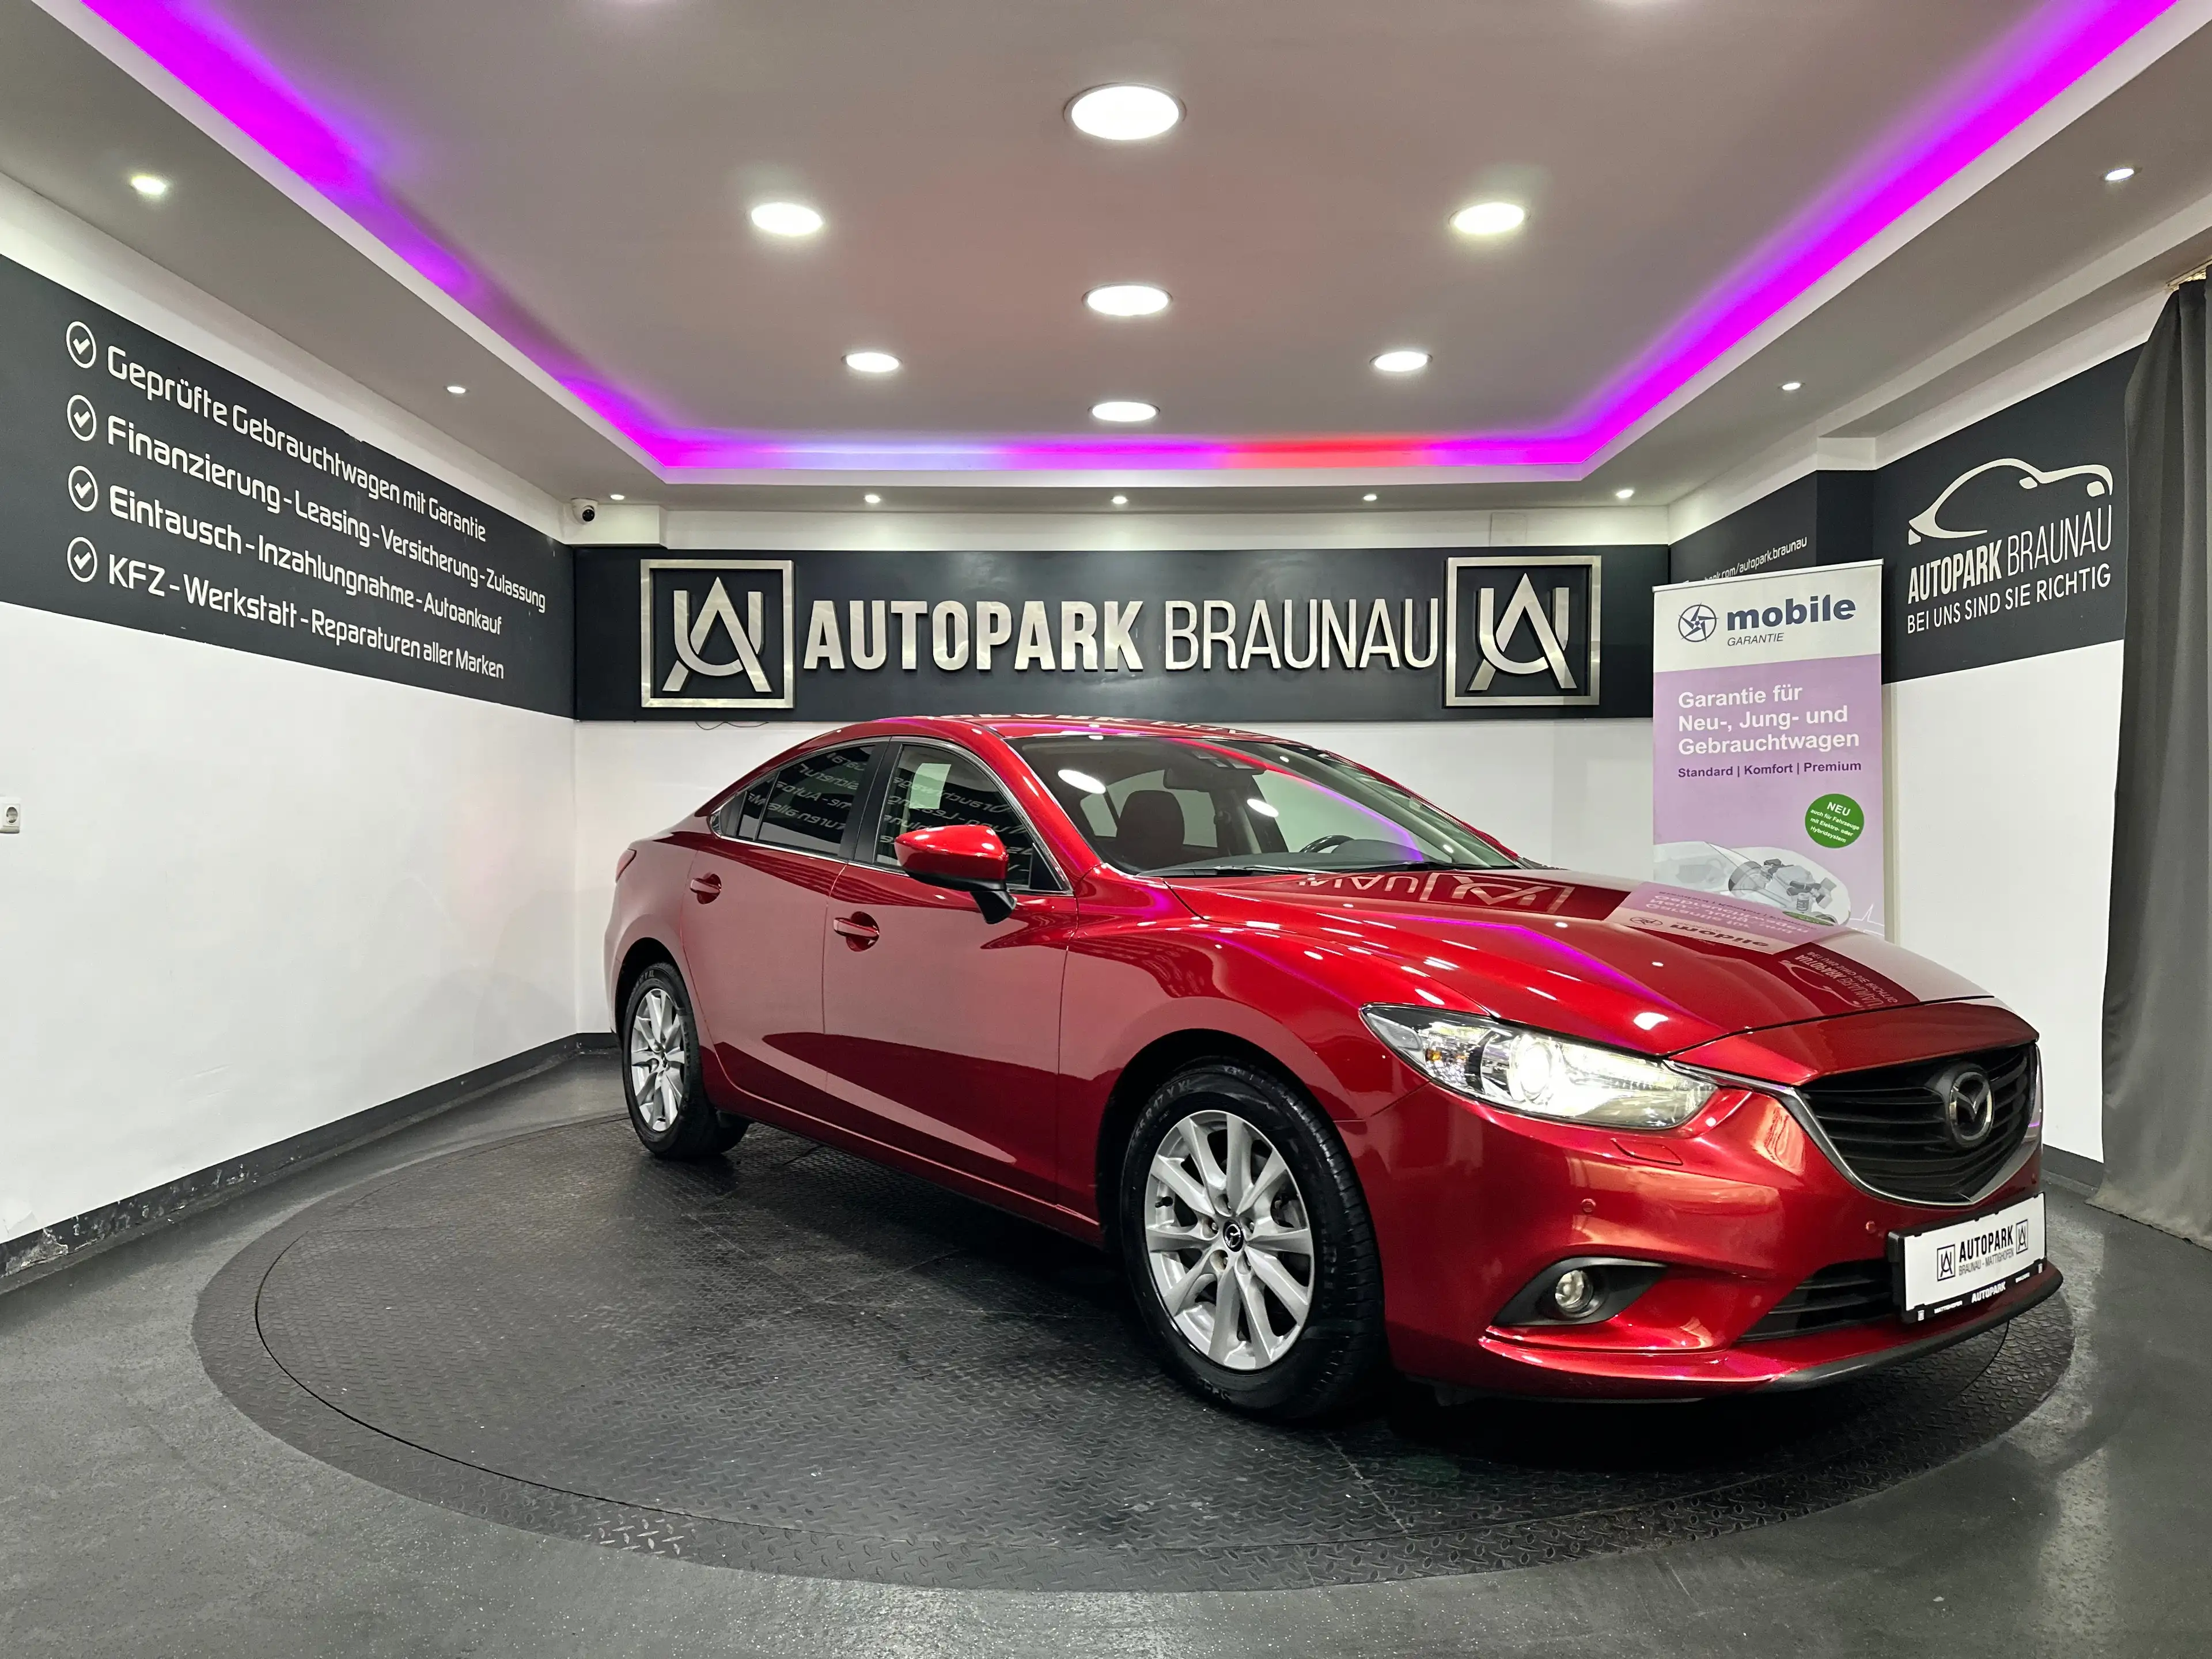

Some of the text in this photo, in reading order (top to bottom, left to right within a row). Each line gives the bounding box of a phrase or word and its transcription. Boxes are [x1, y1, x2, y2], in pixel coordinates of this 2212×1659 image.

[108, 345, 486, 542] Geprüfte Gebrauchtwagen mit Garantie
[108, 415, 281, 514] Finanzierung
[296, 490, 370, 547] Leasing
[380, 524, 478, 588] Versicherung
[487, 568, 546, 613] Zulassung
[109, 484, 242, 555] Eintausch
[259, 535, 414, 608] Inzahlungnahme
[424, 592, 502, 635] Autoankauf
[1908, 504, 2112, 605] AUTOPARK BRAUNAU
[1727, 594, 1856, 631] mobile
[1907, 563, 2111, 634] BEI UNS SIND SIE RICHTIG
[109, 554, 165, 597] KFZ
[183, 574, 297, 628] Werkstatt
[312, 609, 419, 658] Reparaturen
[423, 642, 453, 666] aller
[456, 648, 505, 680] Marken
[804, 598, 1439, 672] AUTOPARK BRAUNAU
[1727, 632, 1785, 646] GARANTIE
[1678, 684, 1803, 709] Garantie für
[1679, 706, 1848, 732] Neu-, Jung- und
[1678, 732, 1859, 755] Gebrauchtwagen
[1678, 766, 1733, 778] Standard
[1744, 763, 1793, 775] Komfort
[1804, 761, 1862, 772] Premium
[1810, 809, 1823, 817] auch
[1832, 816, 1860, 831] Fahrzeuge
[1827, 802, 1851, 816] NEU
[1810, 826, 1846, 843] Hybridsystem
[1959, 1225, 2013, 1263] AUTOPARK
[1971, 1281, 2006, 1304] AUTOPARK
